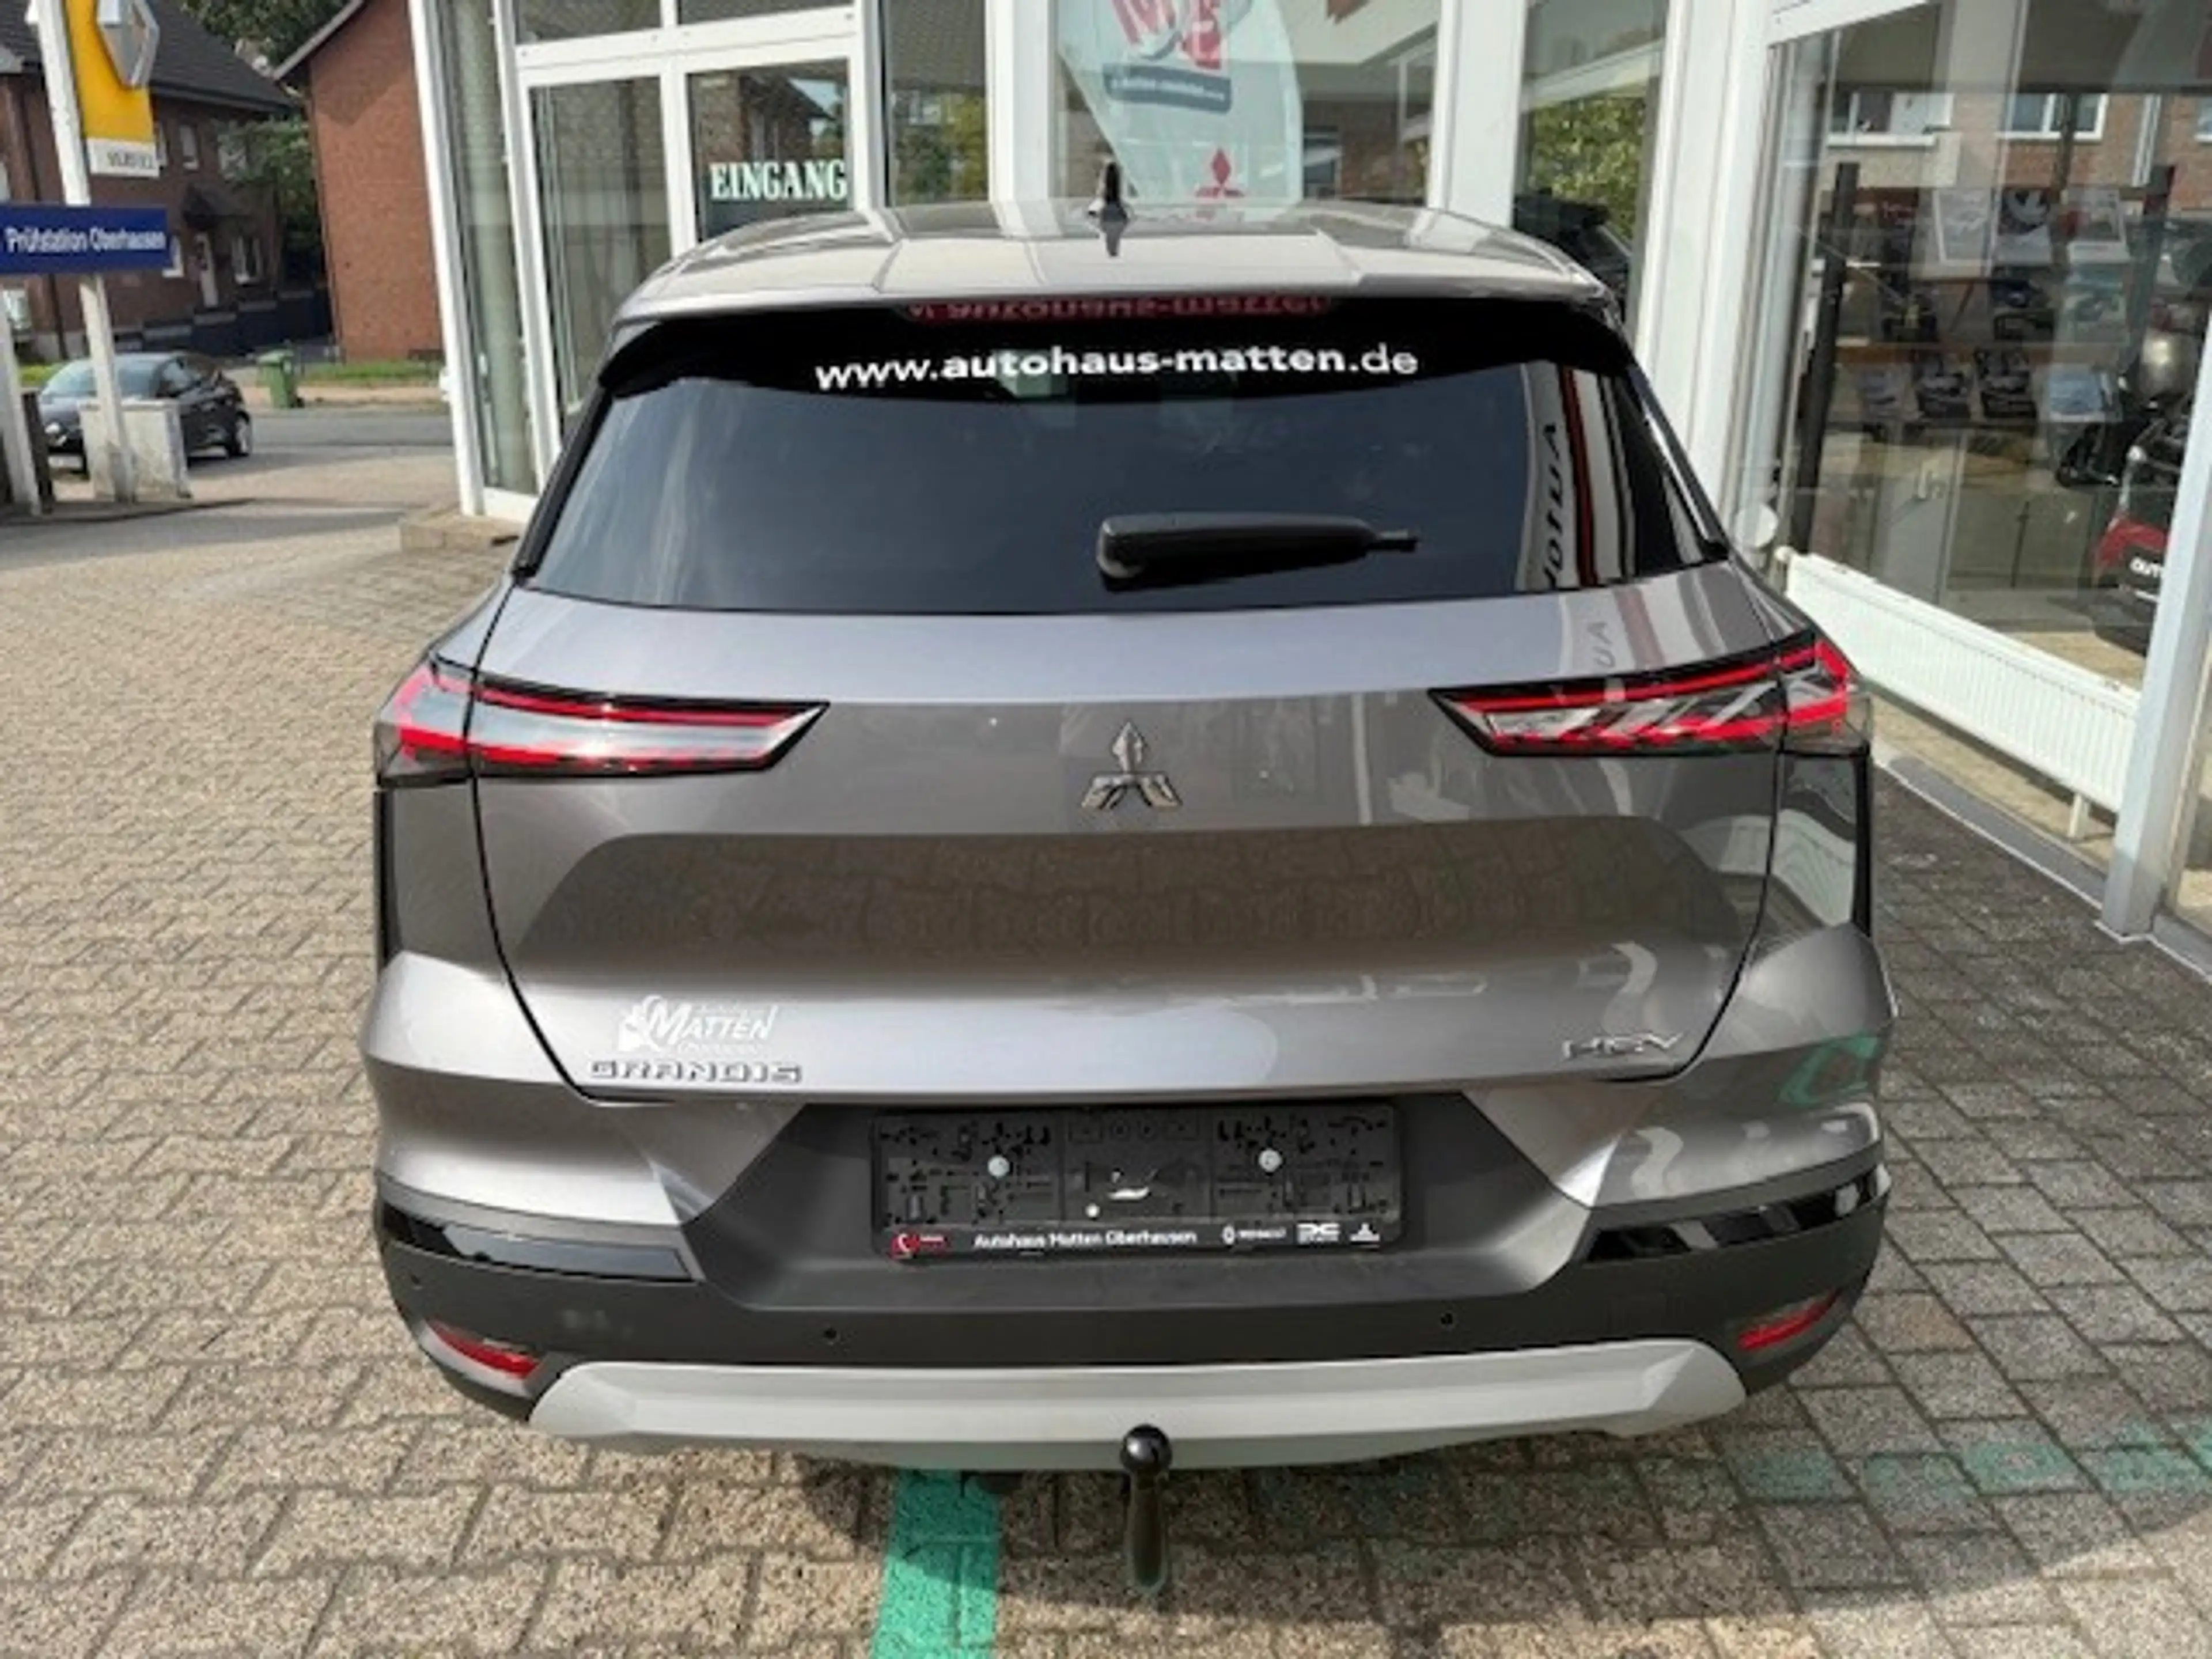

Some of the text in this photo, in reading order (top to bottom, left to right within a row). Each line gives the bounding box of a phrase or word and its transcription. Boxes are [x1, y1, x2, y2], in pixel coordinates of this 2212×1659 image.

[709, 160, 848, 200] EINGANG
[815, 345, 1419, 390] www.autohaus-matten.de
[590, 1059, 802, 1083] GRANDIS
[974, 1232, 1045, 1249] Autohaus
[1105, 1229, 1198, 1245] Oberhausen
